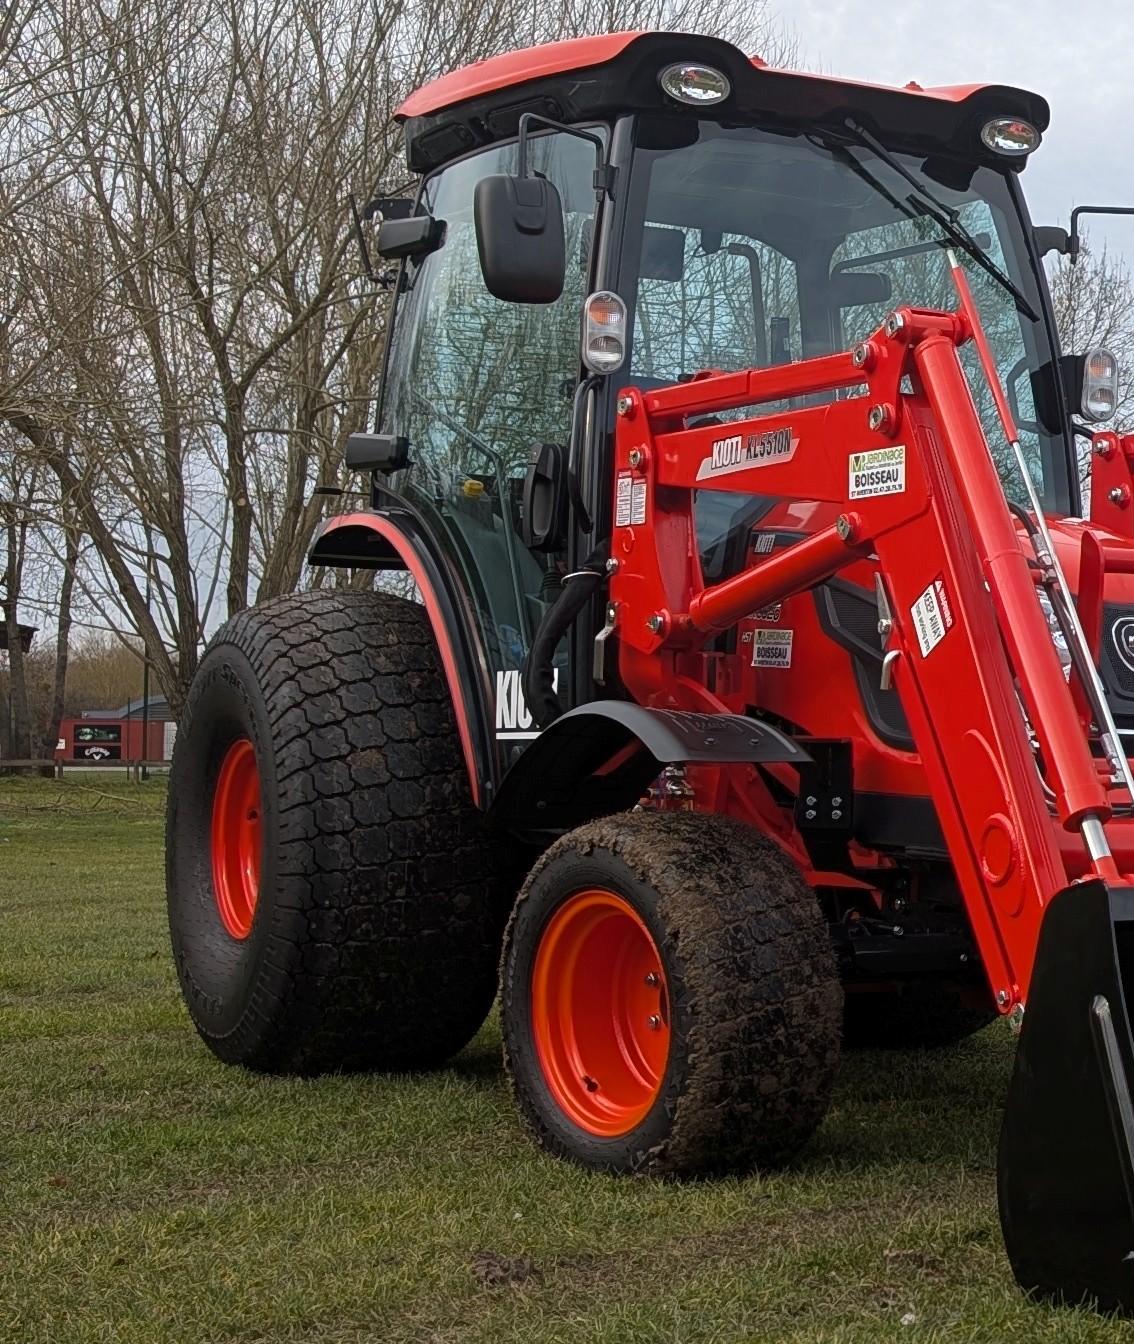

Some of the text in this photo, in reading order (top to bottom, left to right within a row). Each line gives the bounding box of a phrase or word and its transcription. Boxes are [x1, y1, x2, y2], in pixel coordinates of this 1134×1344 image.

[711, 435, 743, 470] KIOTI
[855, 468, 899, 488] BOISSEAU
[756, 646, 788, 660] BOISSEAU
